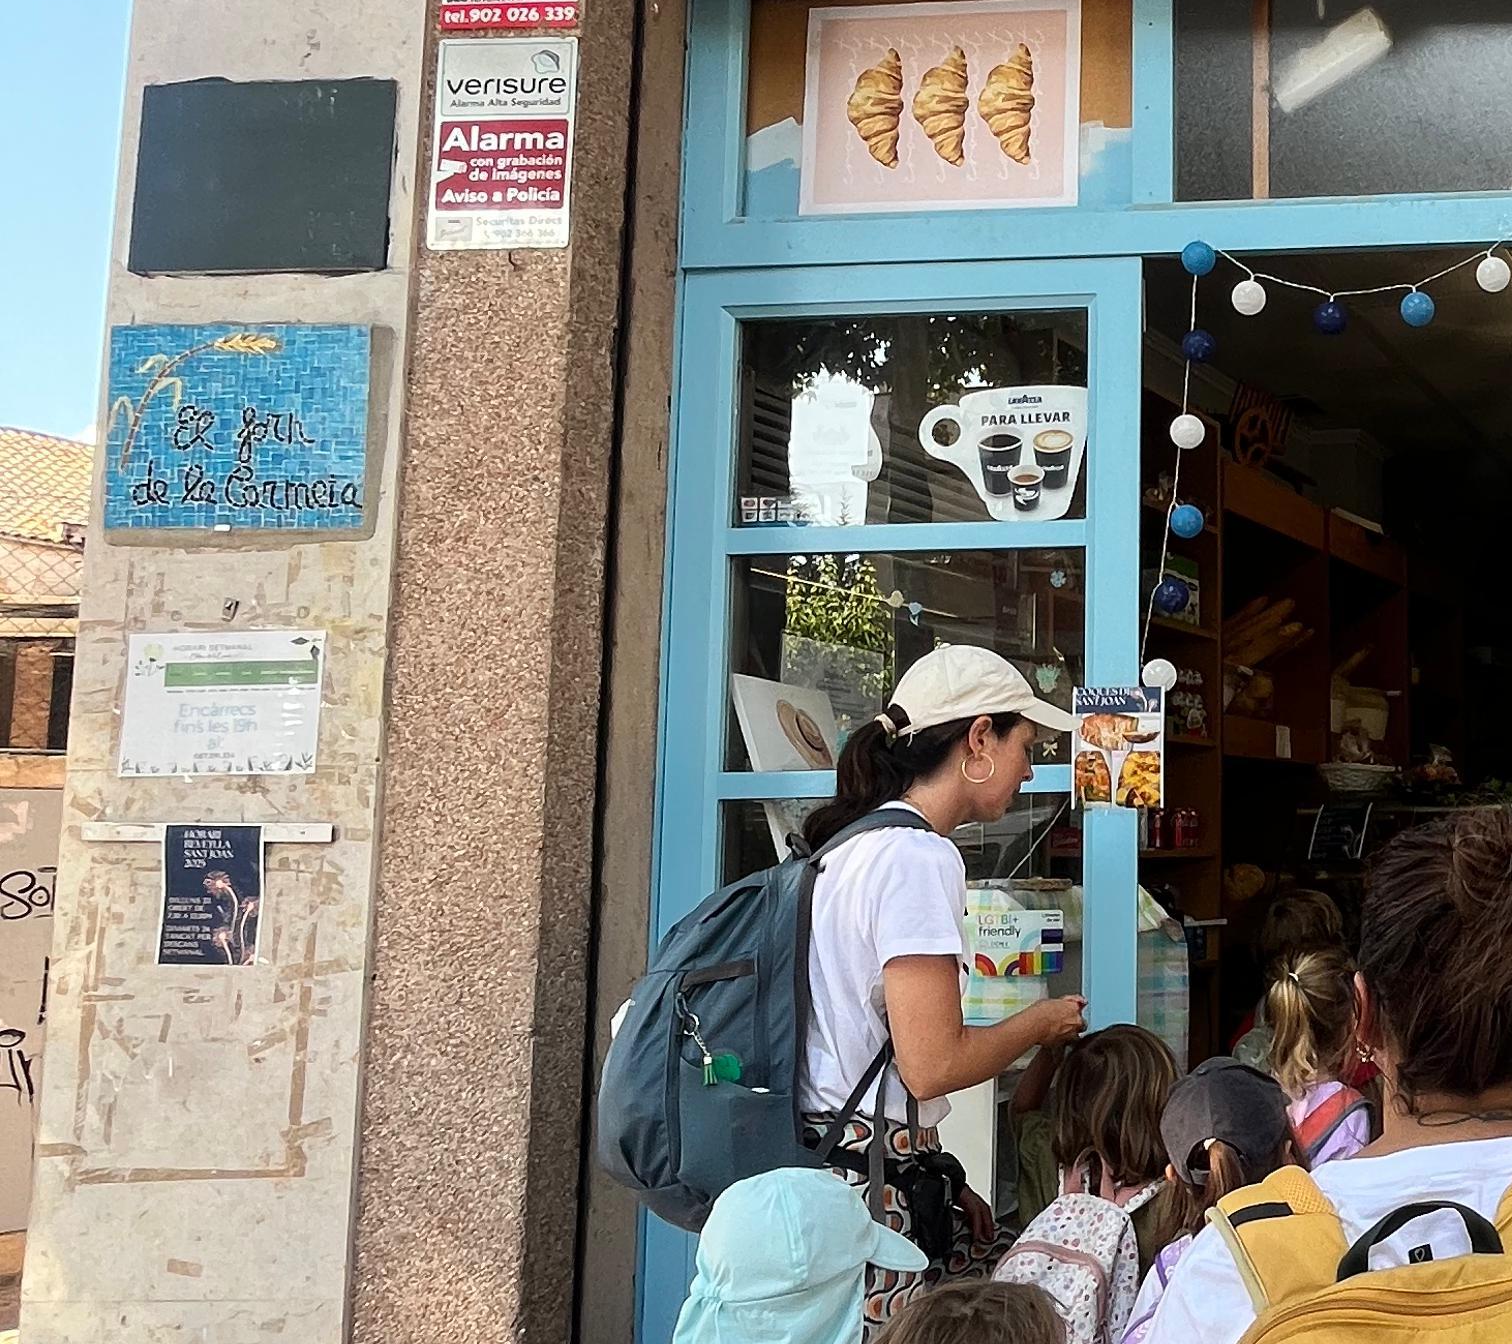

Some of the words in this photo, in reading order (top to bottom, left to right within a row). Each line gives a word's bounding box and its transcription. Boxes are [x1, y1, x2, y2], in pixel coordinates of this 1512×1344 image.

[506, 6, 541, 22] 026
[544, 6, 576, 21] 339
[446, 77, 567, 96] verisure
[450, 99, 485, 108] Alarma
[487, 98, 508, 107] Alta
[511, 97, 562, 109] Seguridad
[441, 124, 566, 153] Alarma
[469, 156, 494, 168] con
[496, 153, 563, 170] grabación
[468, 169, 489, 182] de
[491, 166, 563, 184] imágenes
[441, 188, 489, 204] Aviso
[491, 191, 503, 203] a
[506, 186, 561, 204] Policía
[981, 414, 1017, 426] PARA
[1020, 411, 1071, 425] LLEVAR
[173, 404, 216, 452] El
[131, 459, 171, 506] de
[180, 464, 219, 505] la
[978, 925, 1021, 938] friendly
